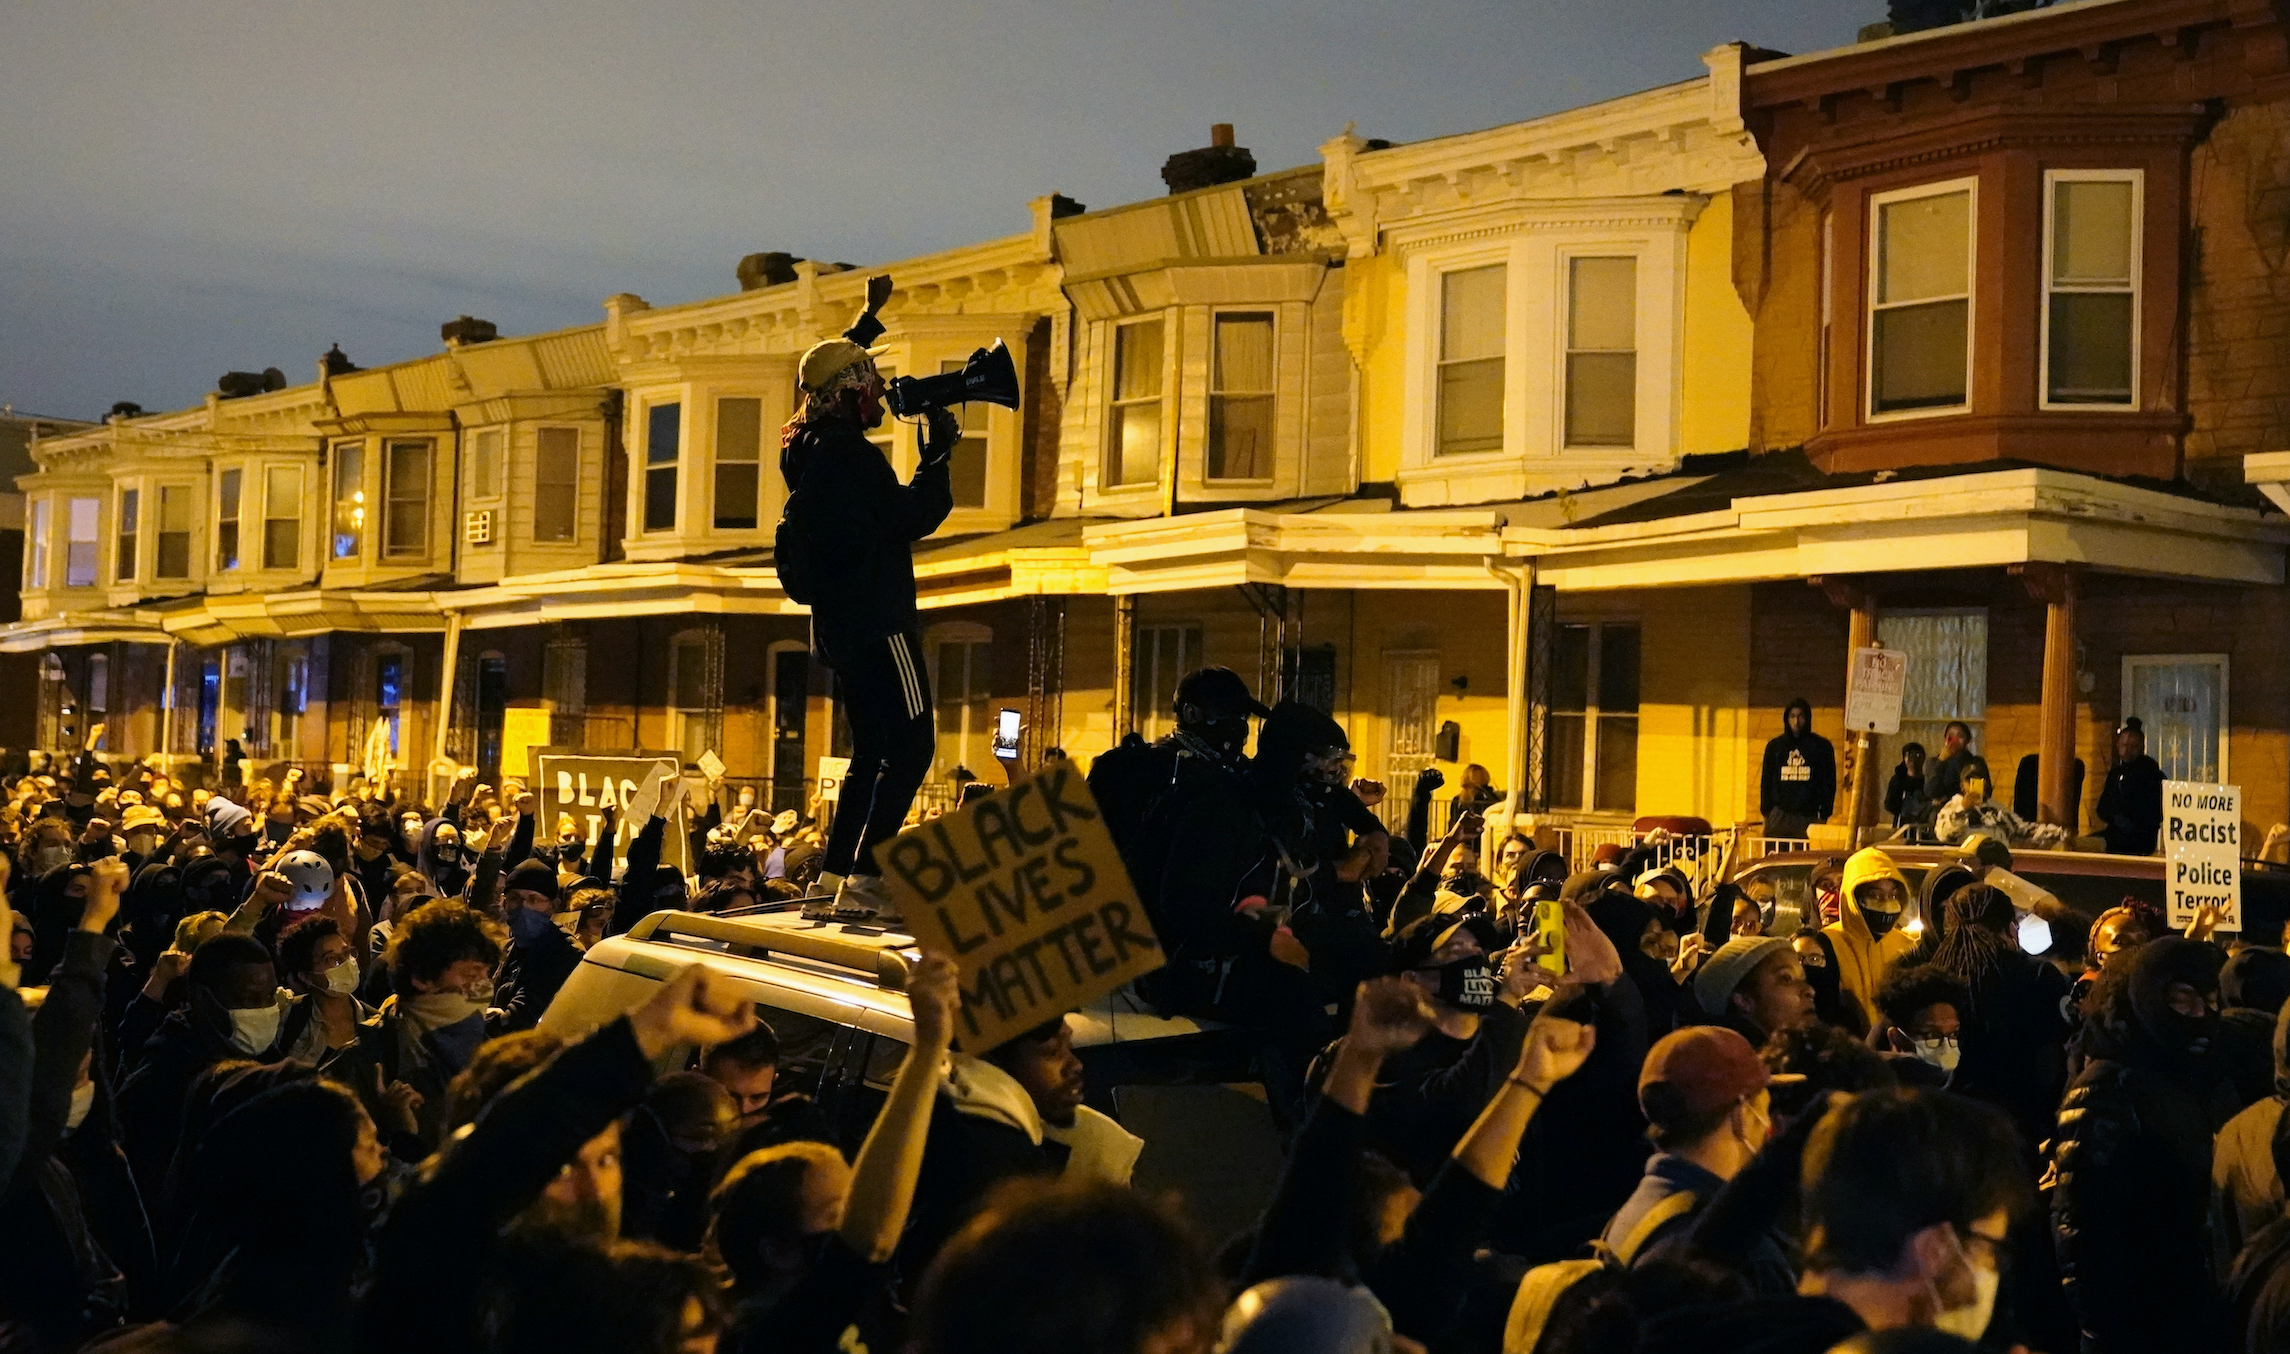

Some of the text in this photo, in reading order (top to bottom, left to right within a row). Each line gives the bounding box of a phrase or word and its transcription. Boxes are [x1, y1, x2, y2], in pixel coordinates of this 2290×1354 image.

[557, 770, 638, 811] BLAC
[2171, 793, 2234, 811] NO MORE
[888, 768, 1096, 903] BLACK
[2169, 816, 2237, 844] Racist
[2176, 862, 2232, 886] Police
[938, 836, 1097, 954] LIVES
[959, 901, 1157, 1036] MATTER
